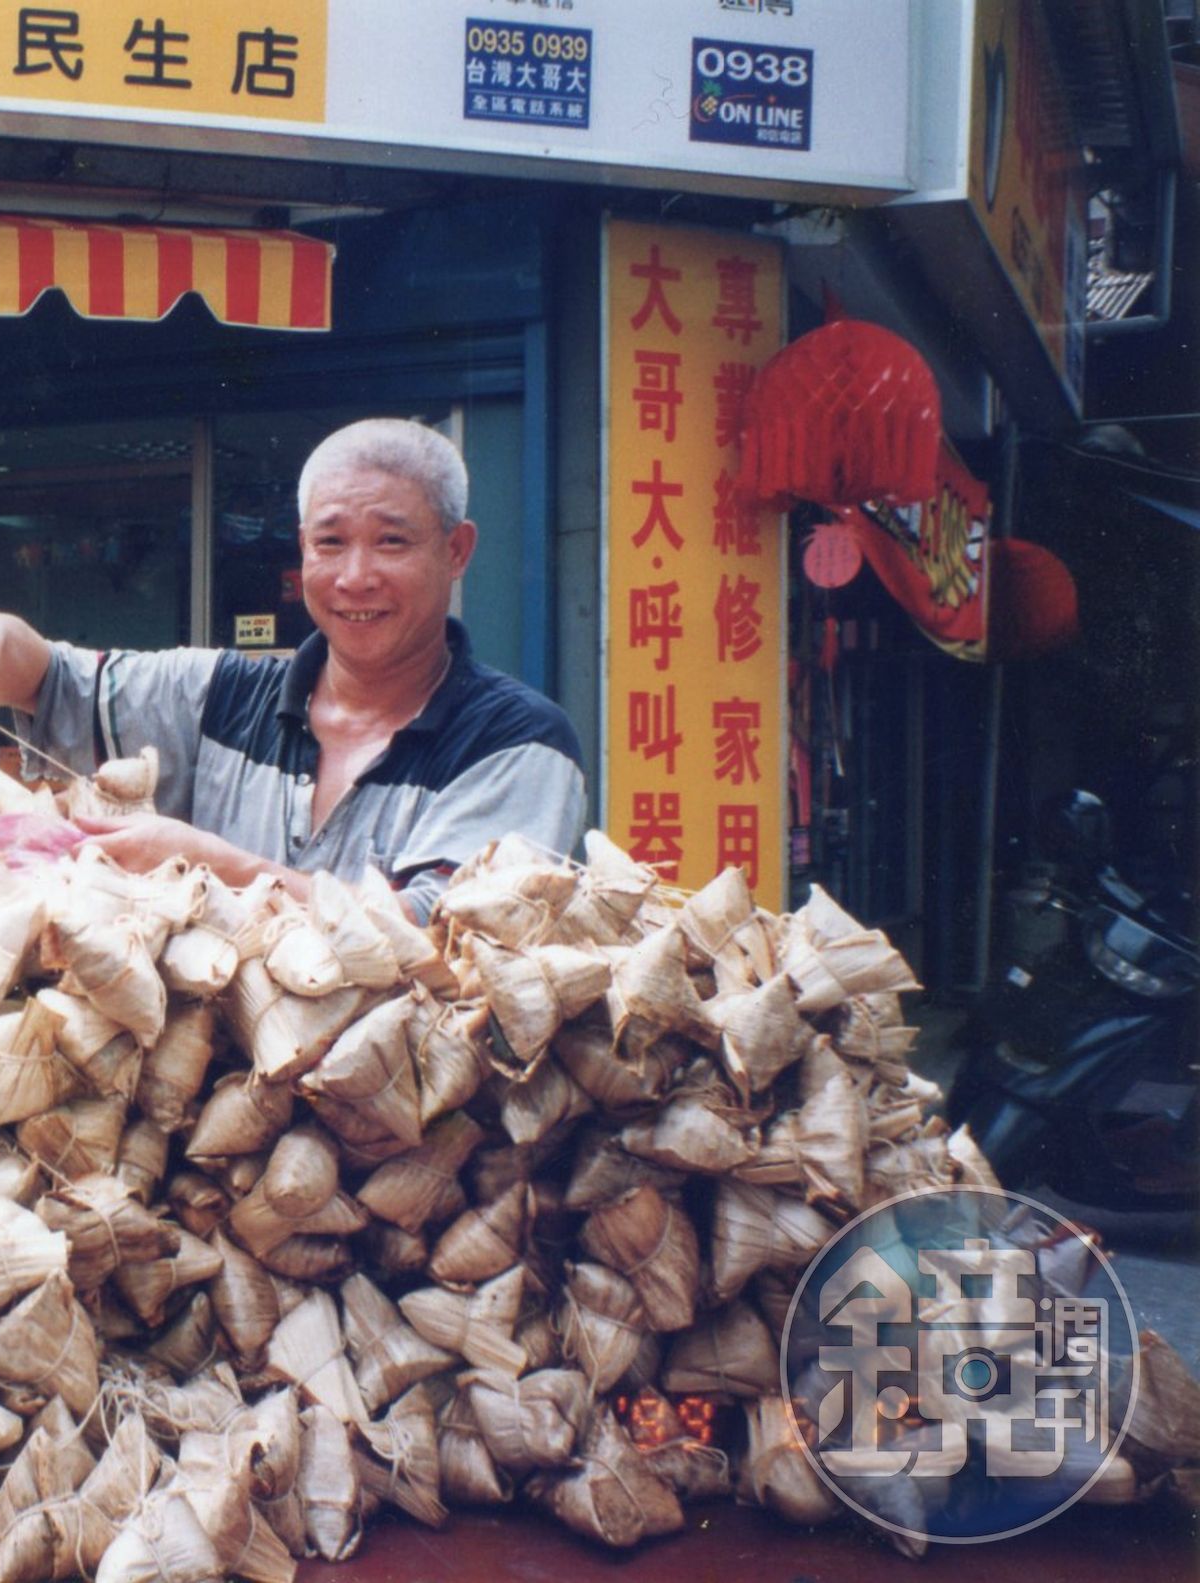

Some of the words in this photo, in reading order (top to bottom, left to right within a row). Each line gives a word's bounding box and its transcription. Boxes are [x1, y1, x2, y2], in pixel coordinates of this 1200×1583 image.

[13, 8, 299, 98] 民生店
[468, 27, 525, 56] 0935
[532, 33, 588, 61] 0939
[466, 56, 587, 93] 台灣大哥大
[697, 47, 809, 87] 0938
[720, 101, 751, 124] ON
[755, 105, 803, 129] LINE
